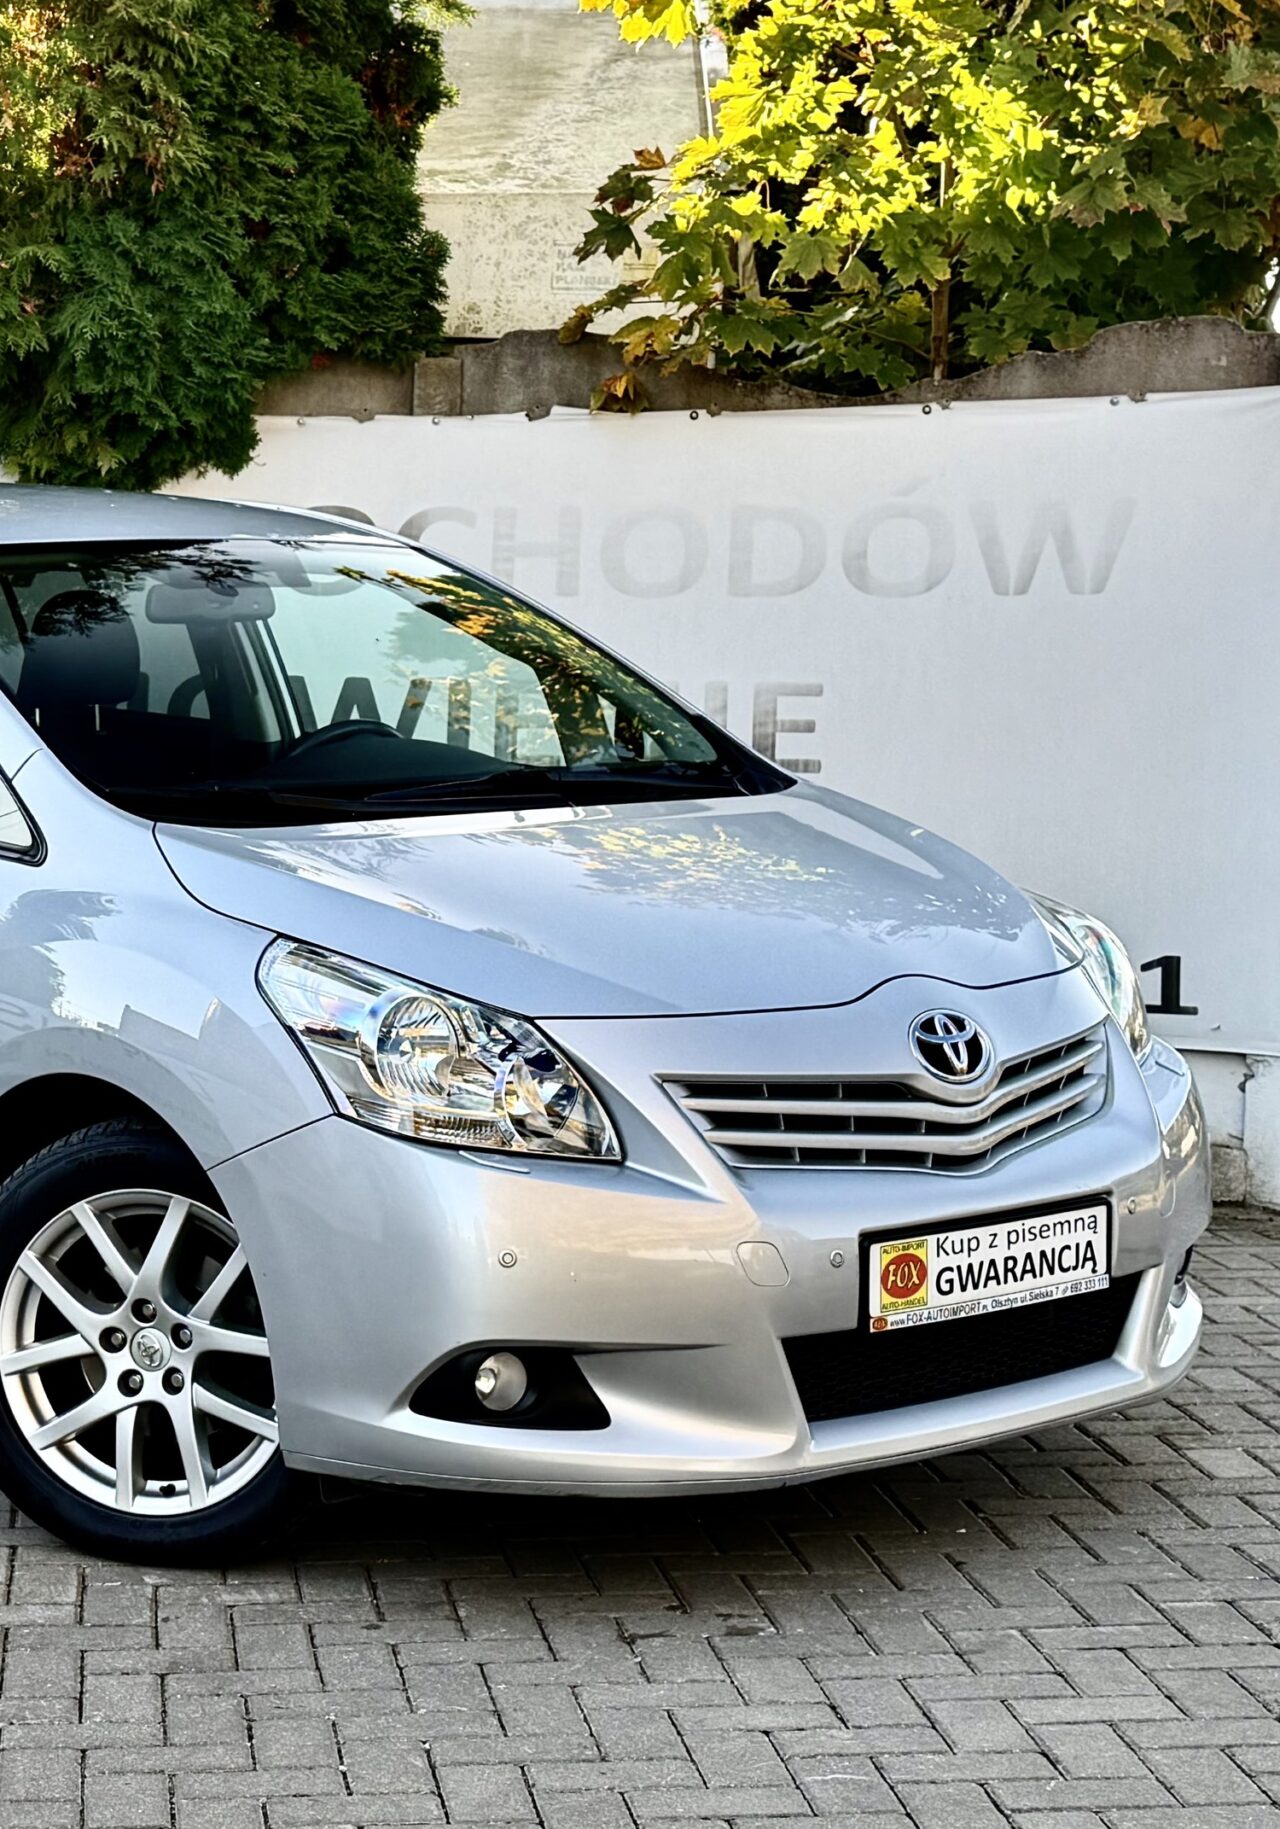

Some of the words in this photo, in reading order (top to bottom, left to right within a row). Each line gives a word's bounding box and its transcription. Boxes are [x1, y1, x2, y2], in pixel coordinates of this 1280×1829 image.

[936, 1236, 980, 1258] Kup
[989, 1232, 998, 1249] z
[1007, 1214, 1099, 1250] pisemną
[887, 1261, 921, 1290] FOX
[935, 1240, 1099, 1296] GWARANCJĄ
